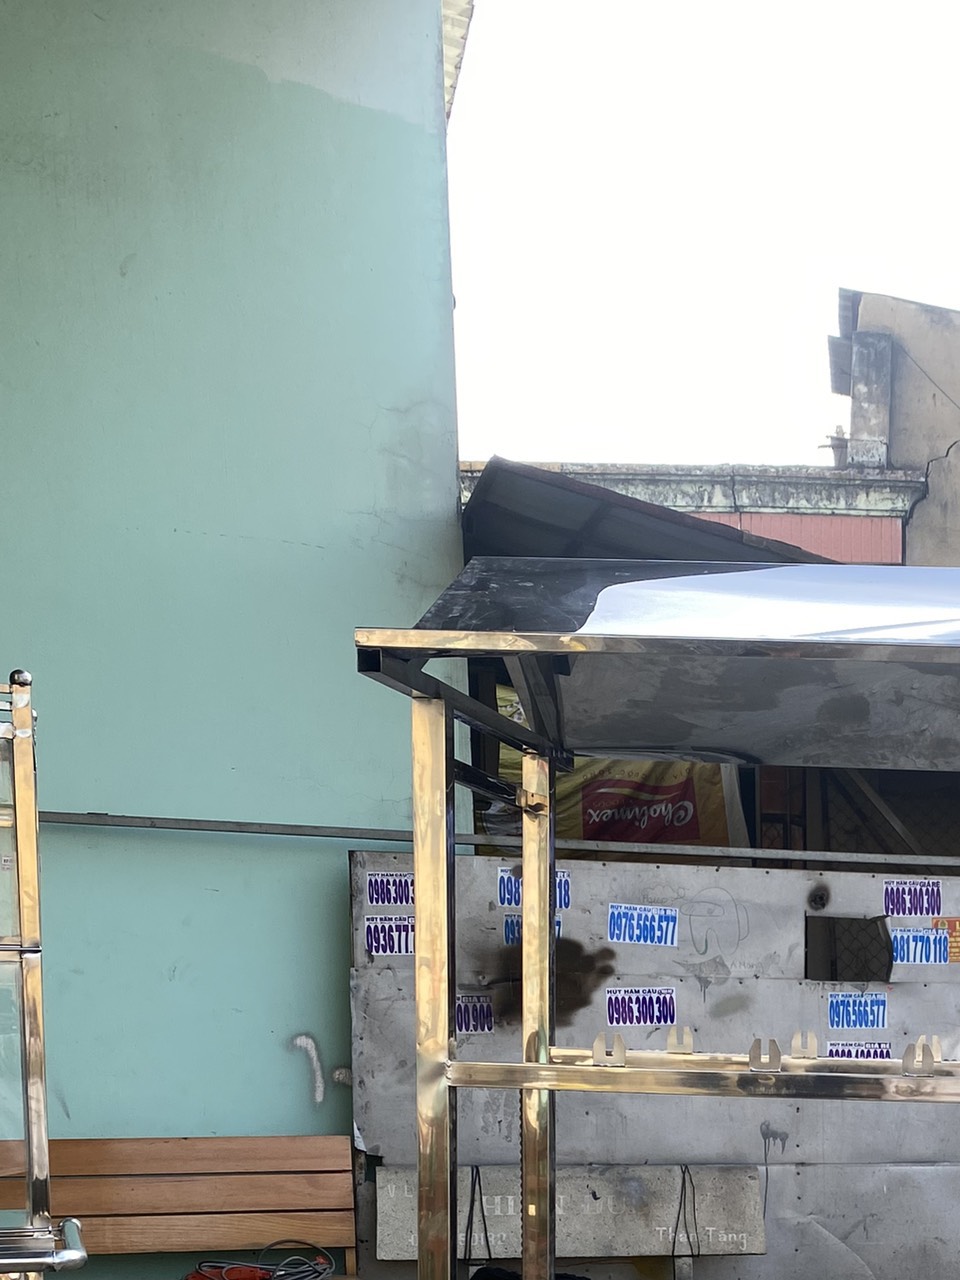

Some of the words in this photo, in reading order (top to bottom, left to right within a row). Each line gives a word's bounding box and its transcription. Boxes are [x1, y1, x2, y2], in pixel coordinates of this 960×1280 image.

[586, 800, 694, 830] Cholimex
[368, 879, 415, 905] 0986.300.3
[884, 887, 941, 916] 0986.300.300
[609, 911, 678, 946] 0976.566.577
[892, 935, 949, 963] 981.770.118
[456, 1003, 493, 1032] 00.900
[607, 995, 675, 1025] 0986.300.300
[829, 999, 887, 1029] 0976.566.577
